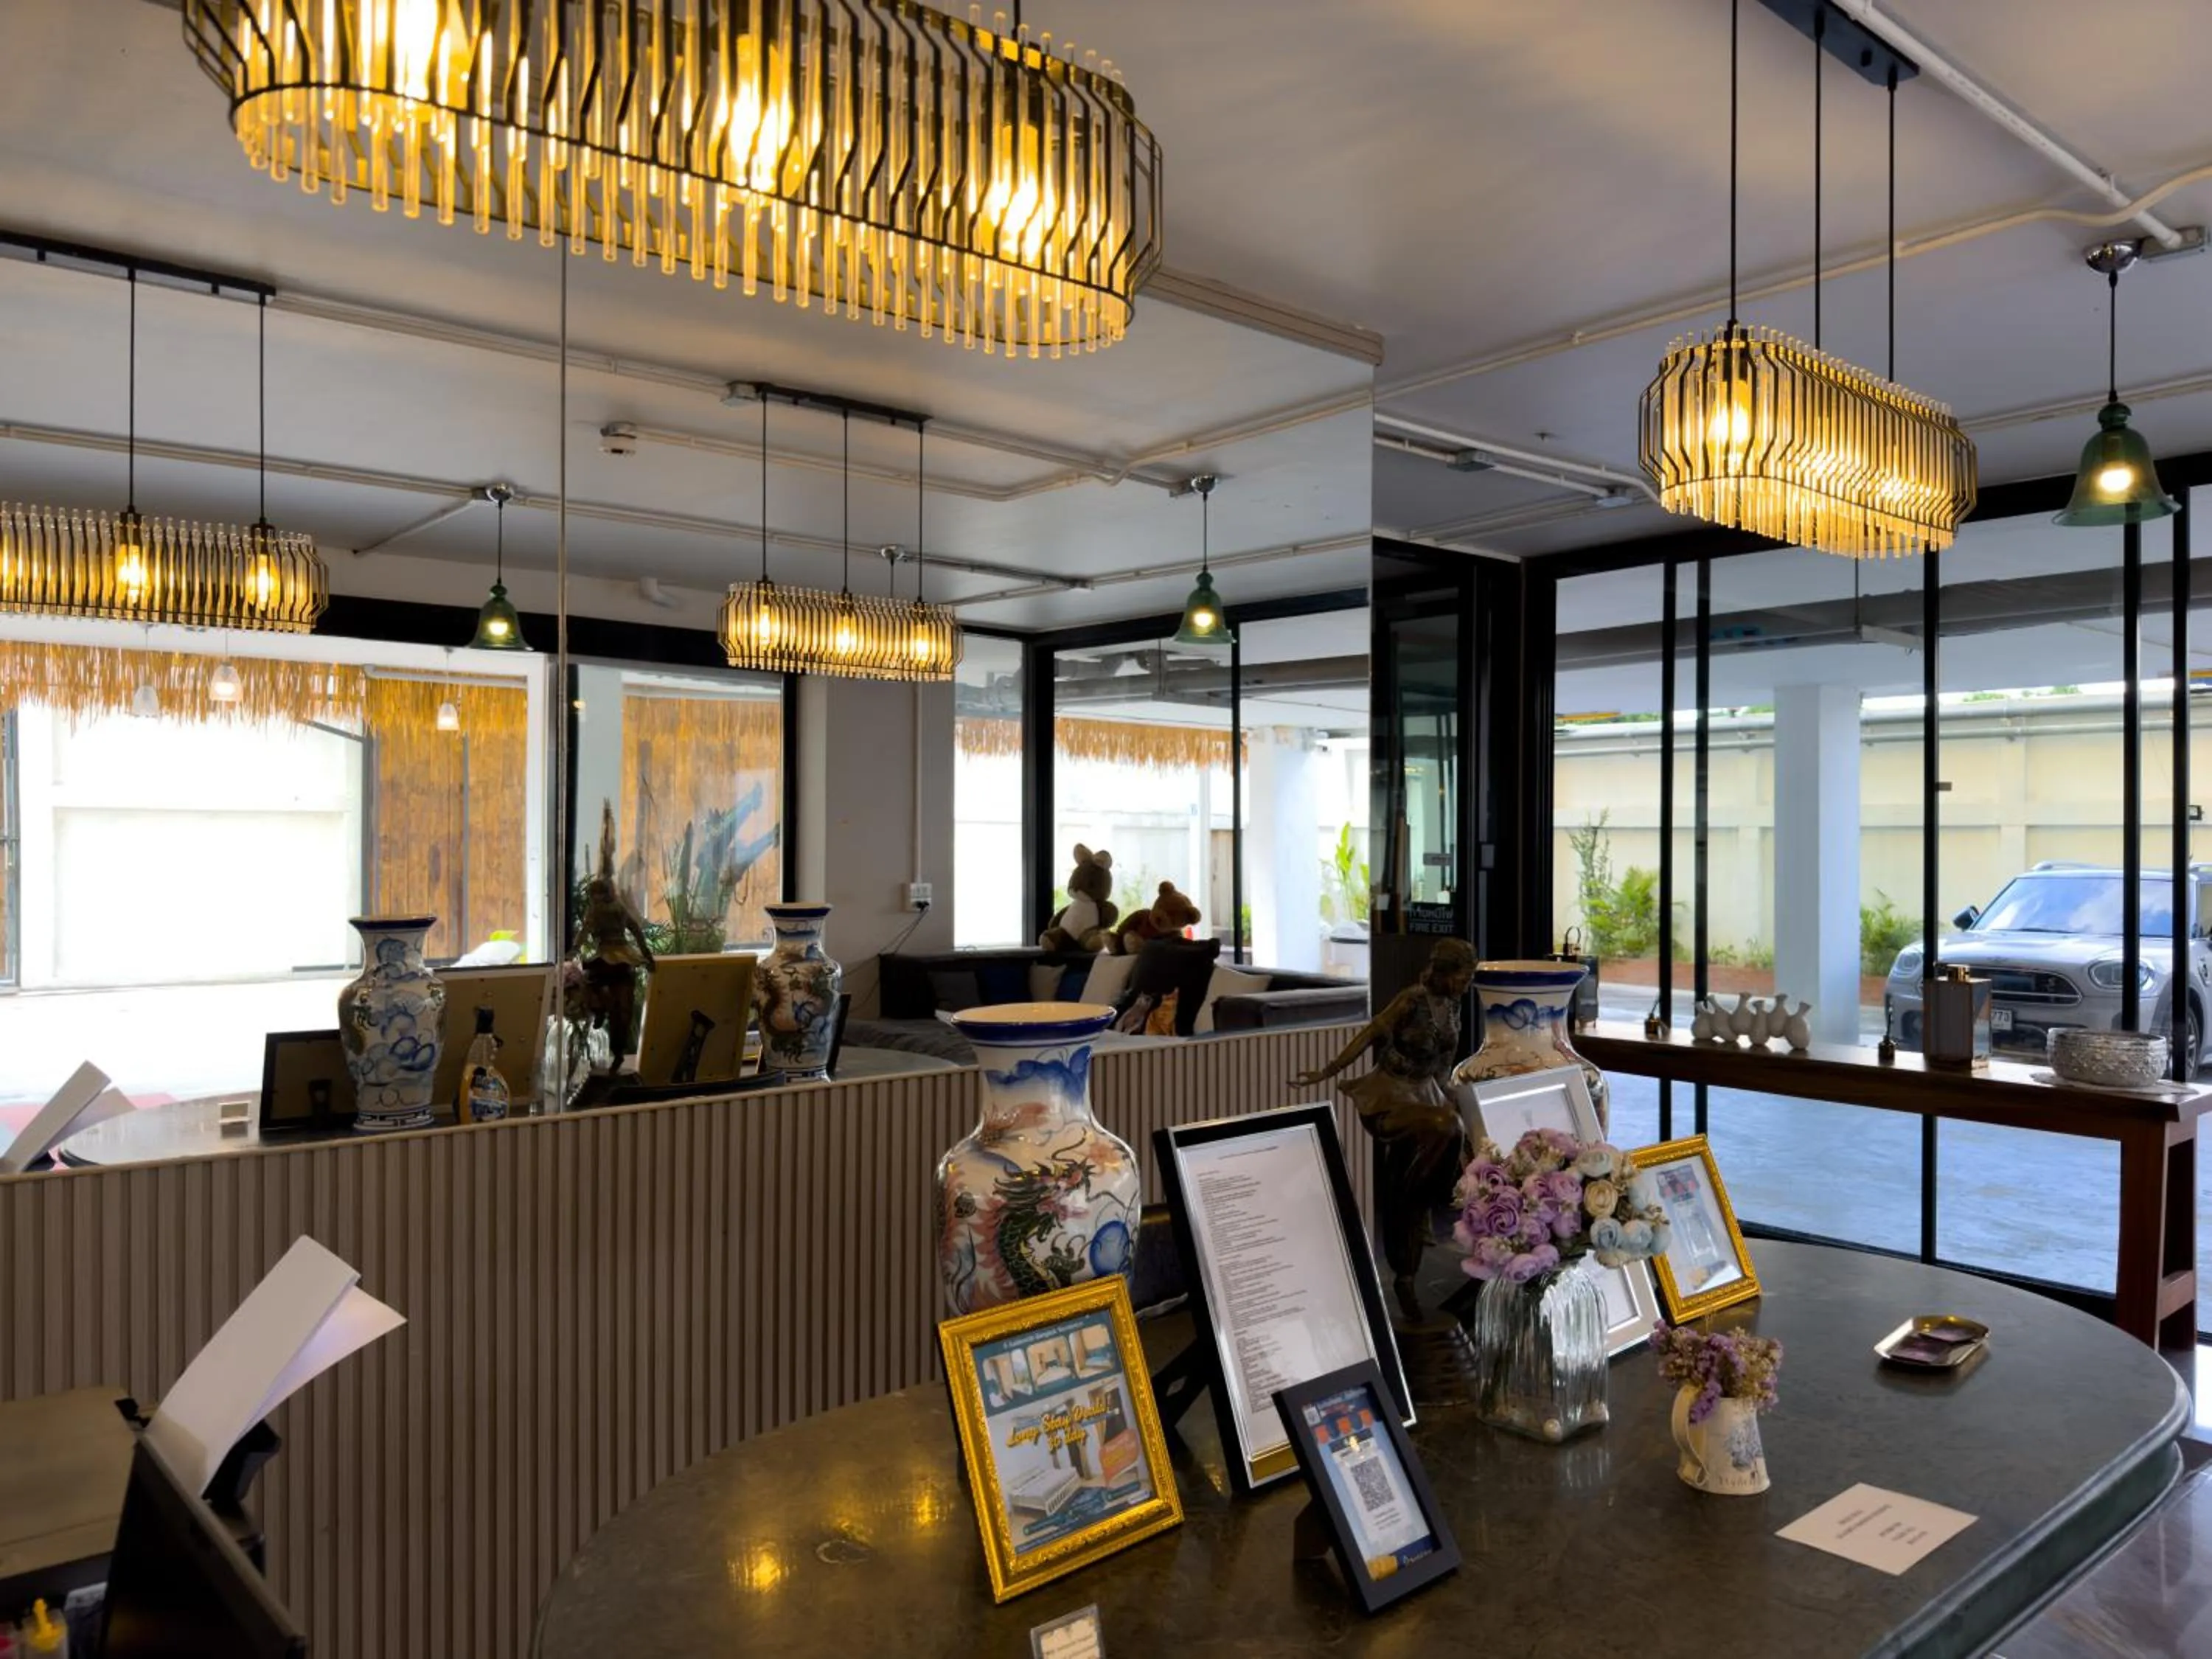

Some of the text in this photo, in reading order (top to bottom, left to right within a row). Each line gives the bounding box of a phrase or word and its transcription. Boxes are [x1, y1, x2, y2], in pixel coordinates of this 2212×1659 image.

[1409, 923, 1454, 933] FIRE EXIT
[1006, 1425, 1040, 1448] Long
[1042, 1413, 1072, 1434] Stay
